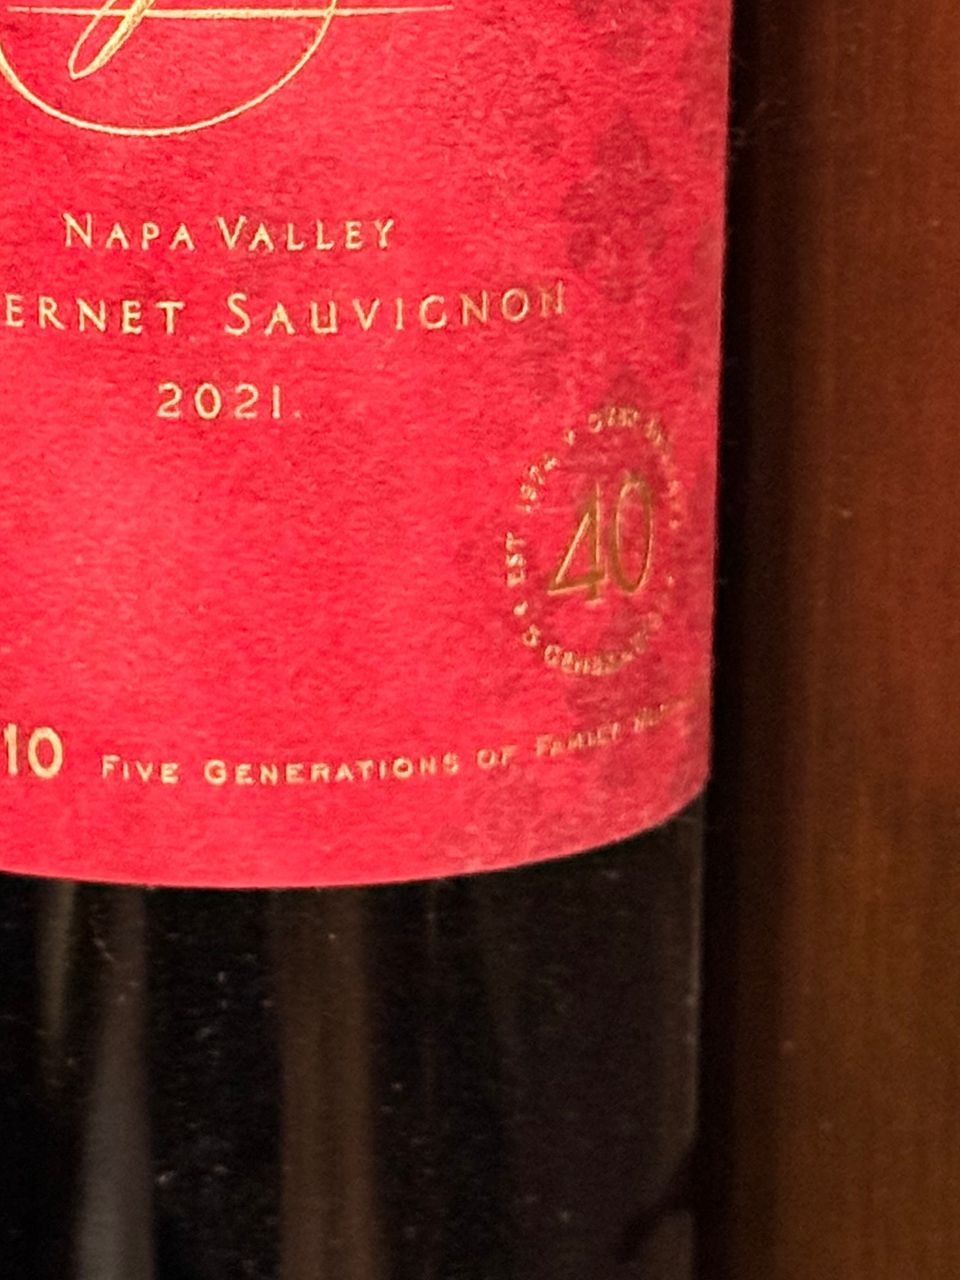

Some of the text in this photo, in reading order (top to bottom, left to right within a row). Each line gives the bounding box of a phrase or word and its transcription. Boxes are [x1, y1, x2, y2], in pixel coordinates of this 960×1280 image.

[64, 213, 395, 253] NAPA VALLEY
[224, 279, 568, 336] SAUVIGNON
[546, 472, 655, 606] 40
[101, 754, 179, 784] FIVE
[203, 751, 459, 785] GENERATIONS
[476, 744, 518, 769] OF
